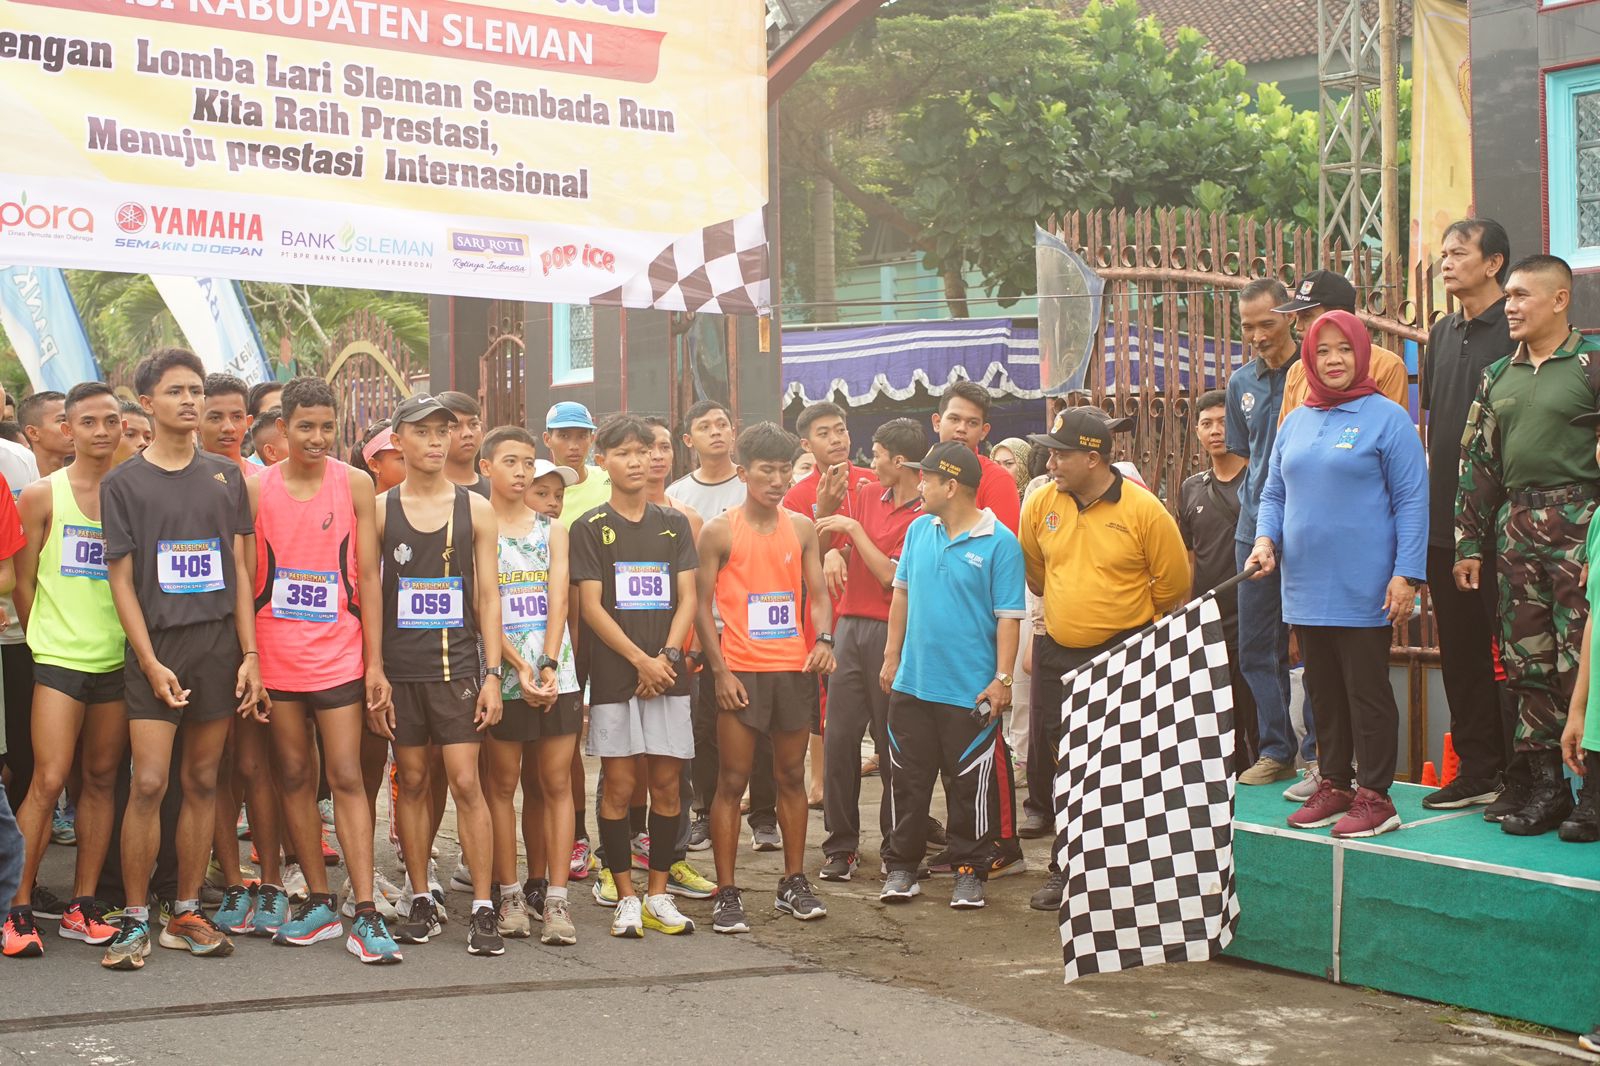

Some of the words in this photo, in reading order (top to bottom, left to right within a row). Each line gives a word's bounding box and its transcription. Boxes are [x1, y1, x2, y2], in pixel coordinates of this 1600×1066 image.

[442, 13, 593, 64] SLEMAN
[136, 38, 255, 84] Lomba
[266, 54, 332, 93] Lari
[344, 64, 462, 108] Sleman
[473, 80, 610, 126] Sembada
[619, 98, 675, 132] Run
[193, 87, 263, 127] Kita
[275, 96, 349, 135] Raih
[362, 106, 498, 155] Prestasi,
[87, 116, 216, 167] Menuju
[226, 141, 363, 177] prestasi
[385, 148, 588, 199] Internasional
[151, 205, 263, 241] YAMAHA
[115, 238, 188, 252] SEMAKIN
[192, 243, 207, 253] DI
[209, 245, 263, 257] DEPAN
[281, 230, 335, 250] BANK
[354, 236, 434, 257] SLEMAN
[457, 236, 485, 250] SARI
[489, 240, 520, 252] ROTI
[314, 254, 336, 262] BANK
[340, 256, 373, 264] SLEMAN
[452, 258, 484, 272] Rotinya
[76, 541, 107, 565] 02
[172, 554, 211, 577] 405
[287, 584, 327, 608] 352
[629, 576, 662, 596] 058
[412, 593, 451, 614] 059
[510, 596, 548, 617] 406
[769, 605, 789, 625] 08
